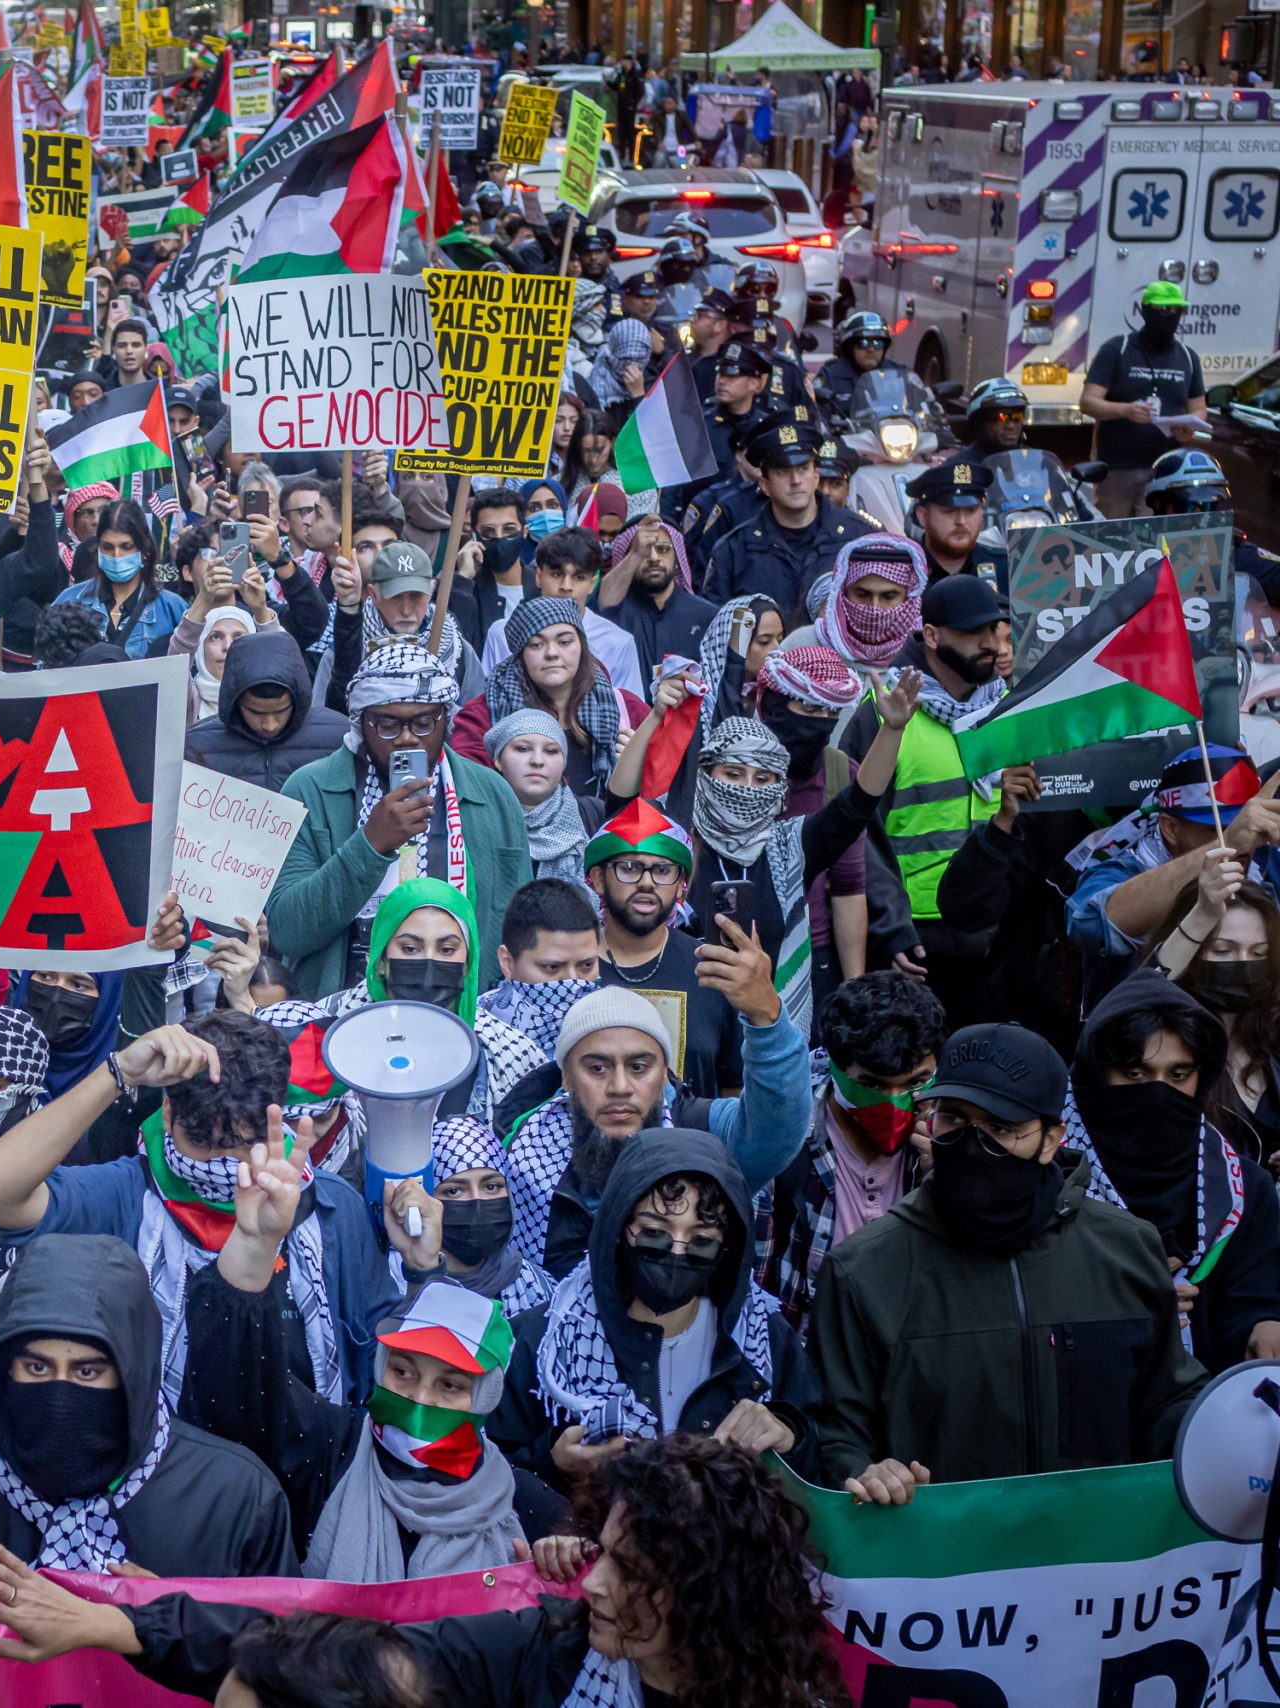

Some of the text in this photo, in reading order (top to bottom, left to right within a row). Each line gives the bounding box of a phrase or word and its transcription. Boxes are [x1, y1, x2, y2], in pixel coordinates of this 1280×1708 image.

[104, 78, 149, 90] RESISTANCE
[424, 71, 478, 84] RESISTANCE
[105, 91, 146, 111] IS NOT
[424, 85, 474, 109] IS NOT
[506, 109, 550, 126] END THE
[502, 136, 545, 160] NOW!
[1048, 143, 1083, 159] 1953
[1110, 141, 1180, 153] EMERGENCY
[1183, 141, 1233, 153] MEDICAL
[22, 134, 83, 190] REE
[26, 188, 88, 219] STINE
[427, 272, 570, 306] STAND WITH
[232, 282, 431, 351] WE WILL NOT
[1175, 320, 1216, 335] ealth
[434, 331, 563, 377] ND THE
[235, 342, 438, 396] STAND FOR
[441, 374, 554, 408] CUPATION
[259, 388, 450, 449] GENOCIDE
[414, 460, 434, 469] Party
[449, 462, 485, 472] Socialism
[504, 466, 542, 474] Liberation
[398, 554, 414, 572] NY
[1055, 787, 1091, 795] LIFETIME
[184, 777, 292, 840] colonialism
[174, 826, 275, 889] thnic cleansing
[950, 1040, 1031, 1081] BROOKLYN
[843, 1568, 1242, 1653] NOW, "JUST
